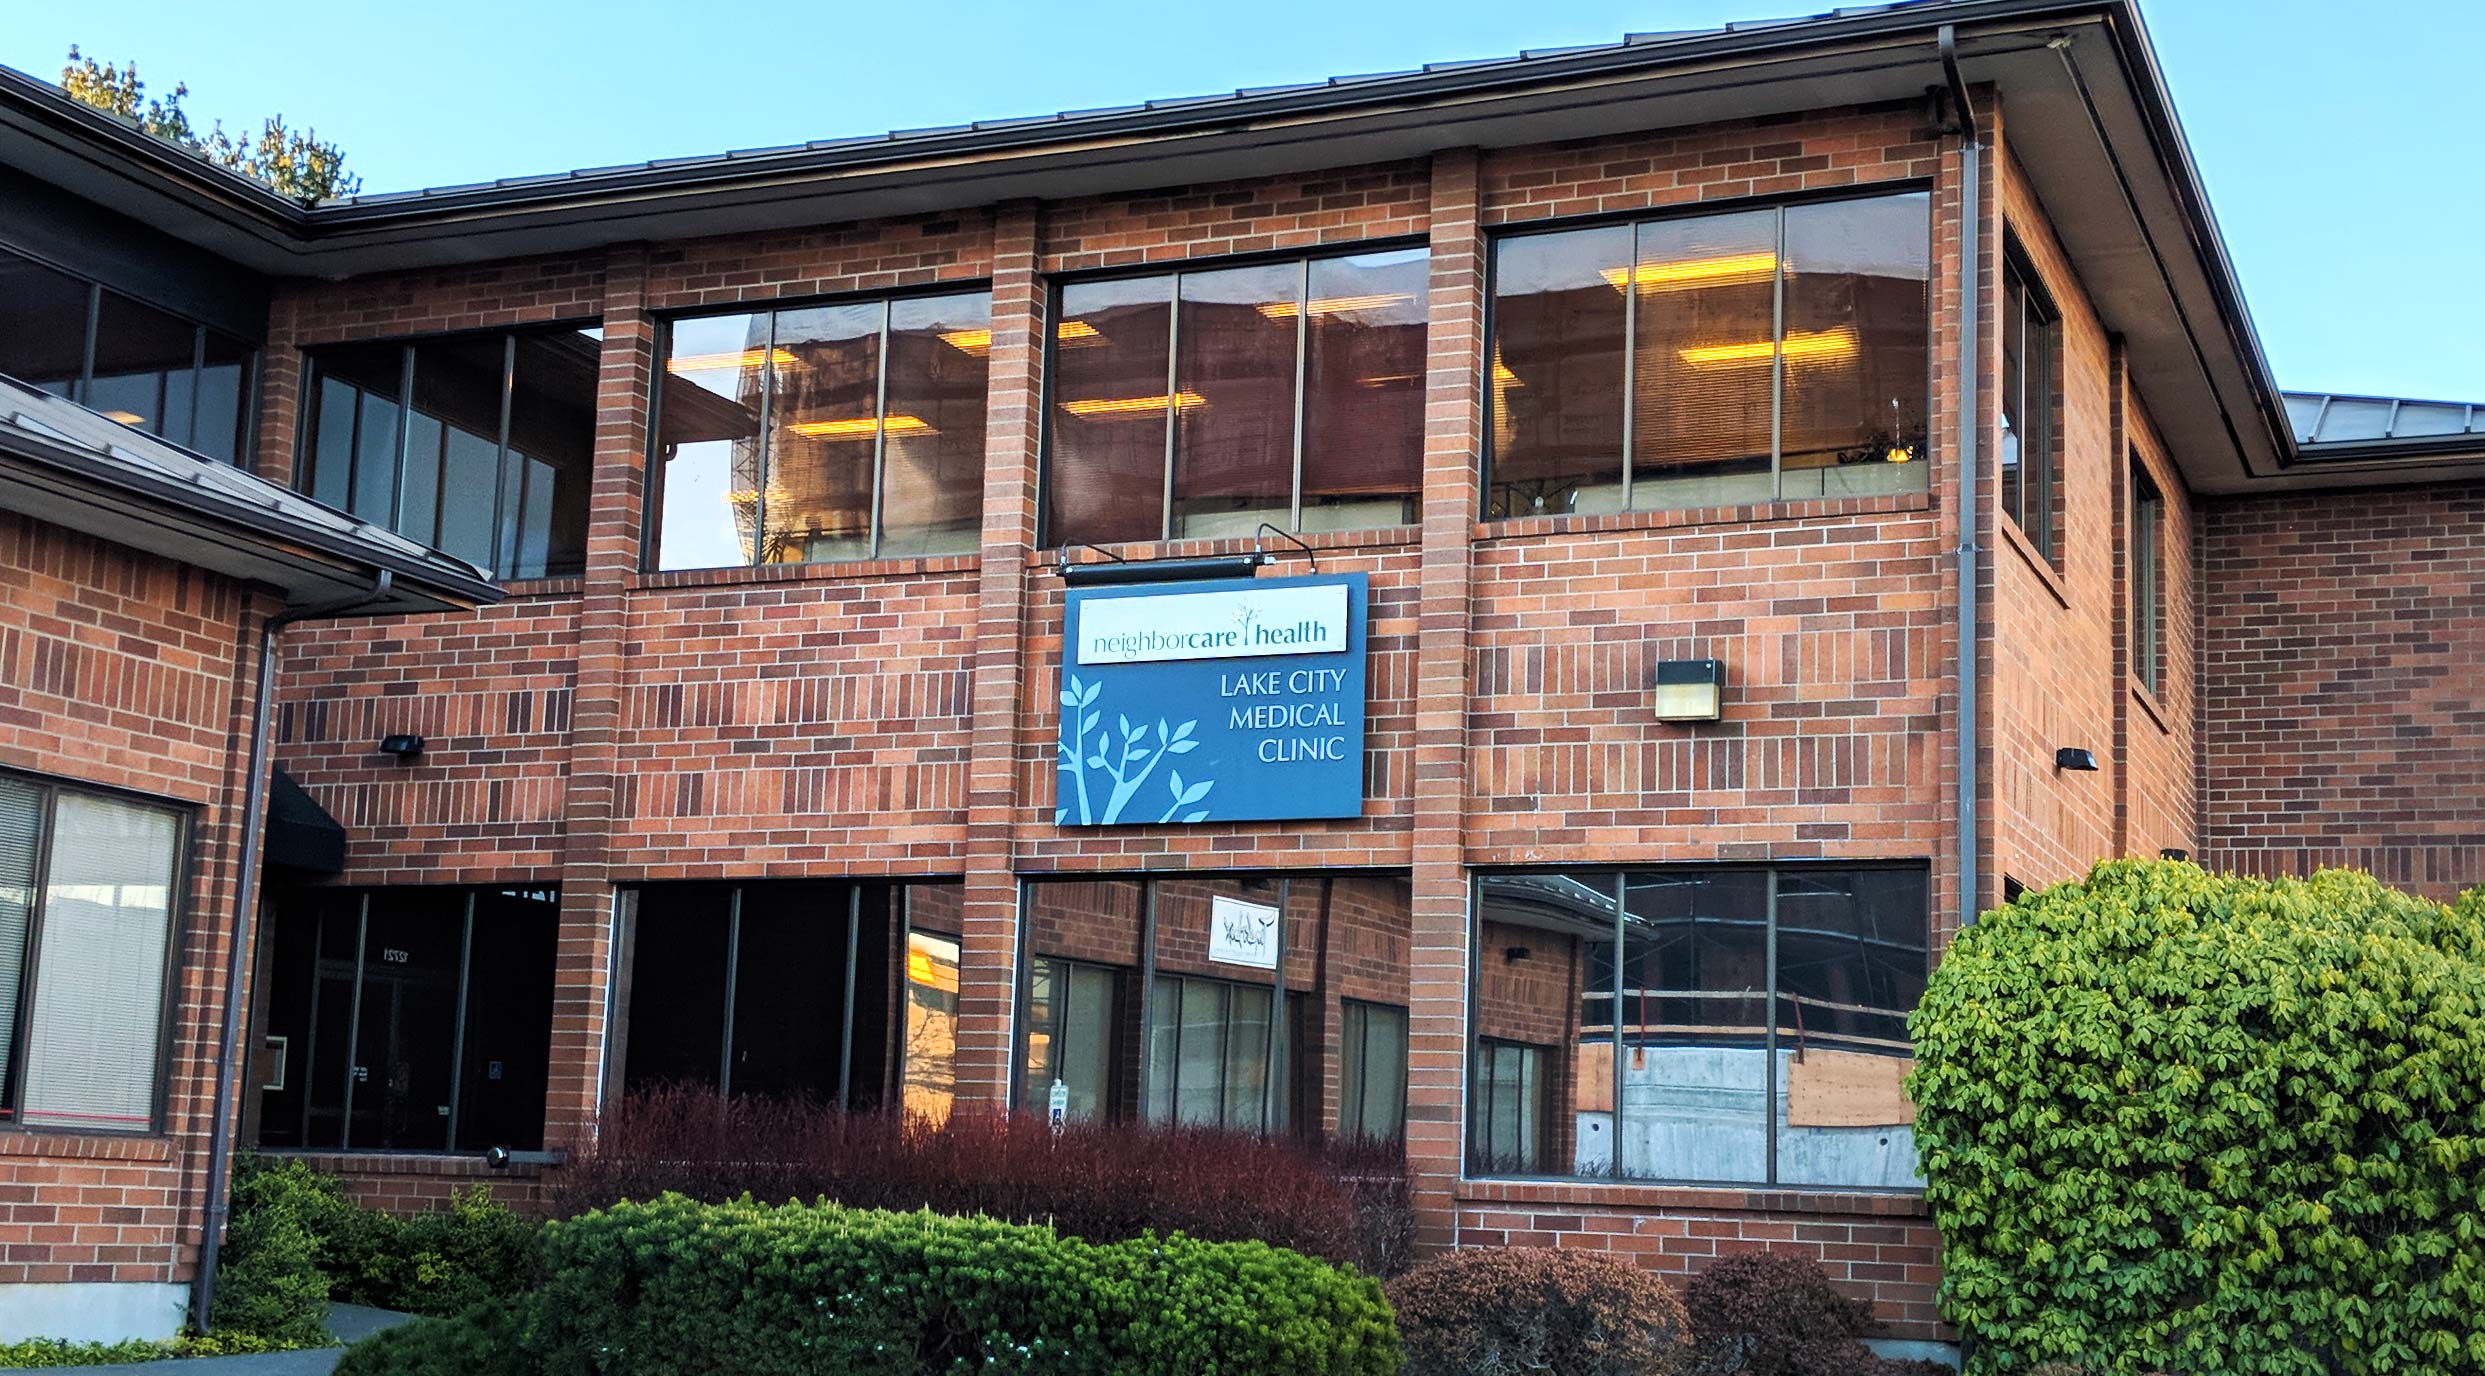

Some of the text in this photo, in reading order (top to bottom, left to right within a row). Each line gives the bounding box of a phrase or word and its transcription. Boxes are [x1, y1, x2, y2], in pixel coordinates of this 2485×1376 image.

[1094, 620, 1327, 659] neighborcare health
[1221, 668, 1347, 697] LAKE CITY
[1229, 702, 1346, 730] MEDICAL
[1258, 736, 1345, 763] CLINIC
